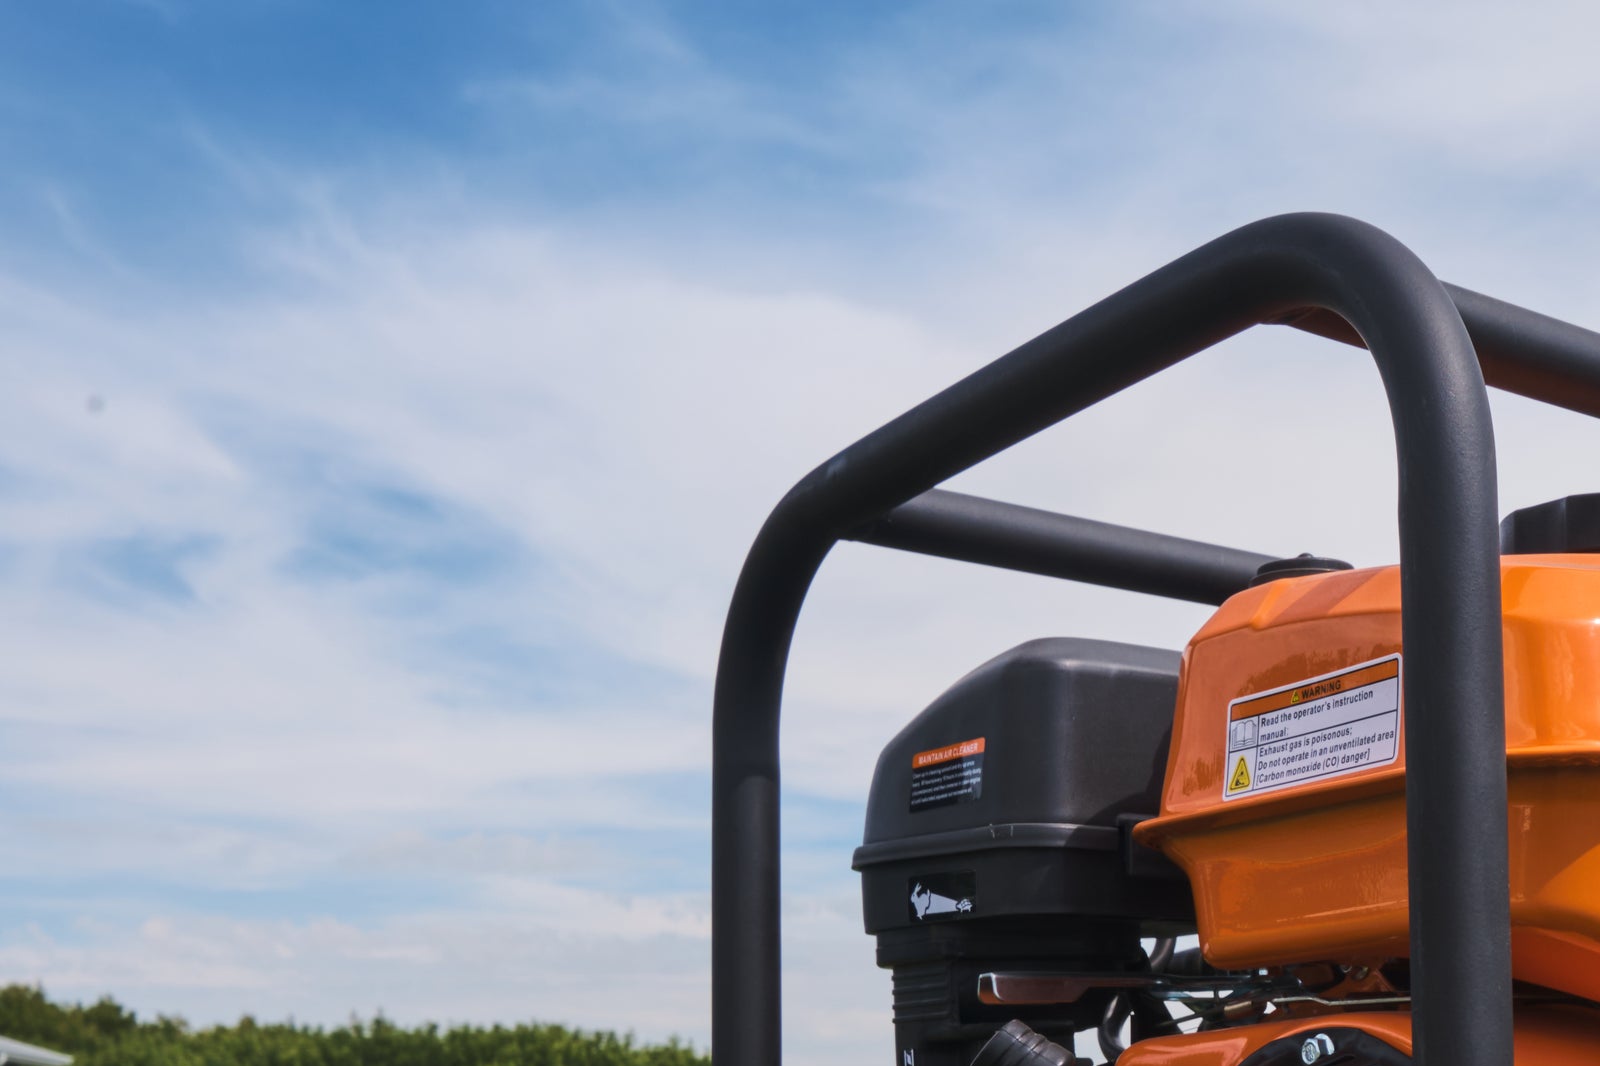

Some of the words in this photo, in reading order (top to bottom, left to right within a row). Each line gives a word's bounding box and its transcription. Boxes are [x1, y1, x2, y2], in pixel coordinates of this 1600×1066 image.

[1302, 680, 1341, 699] WARNING
[1261, 714, 1279, 727] Read
[1280, 712, 1292, 722] the
[1293, 701, 1330, 720] operator's
[1332, 690, 1373, 709] instruction
[918, 752, 943, 765] MAINTAIN
[944, 748, 952, 758] AIR
[952, 742, 978, 756] CLEANER
[1258, 760, 1268, 771] Do
[1268, 756, 1281, 766] not
[1282, 751, 1310, 766] operate
[1310, 748, 1318, 758] in
[1318, 746, 1328, 756] an
[1329, 733, 1376, 754] unventilated
[1377, 730, 1394, 742] area
[1260, 742, 1288, 758] Exhaust
[1290, 740, 1302, 752] gas
[1304, 736, 1310, 746] is
[1286, 761, 1321, 777] monoxide
[1322, 756, 1340, 771] (CO)
[1340, 748, 1370, 764] danger]
